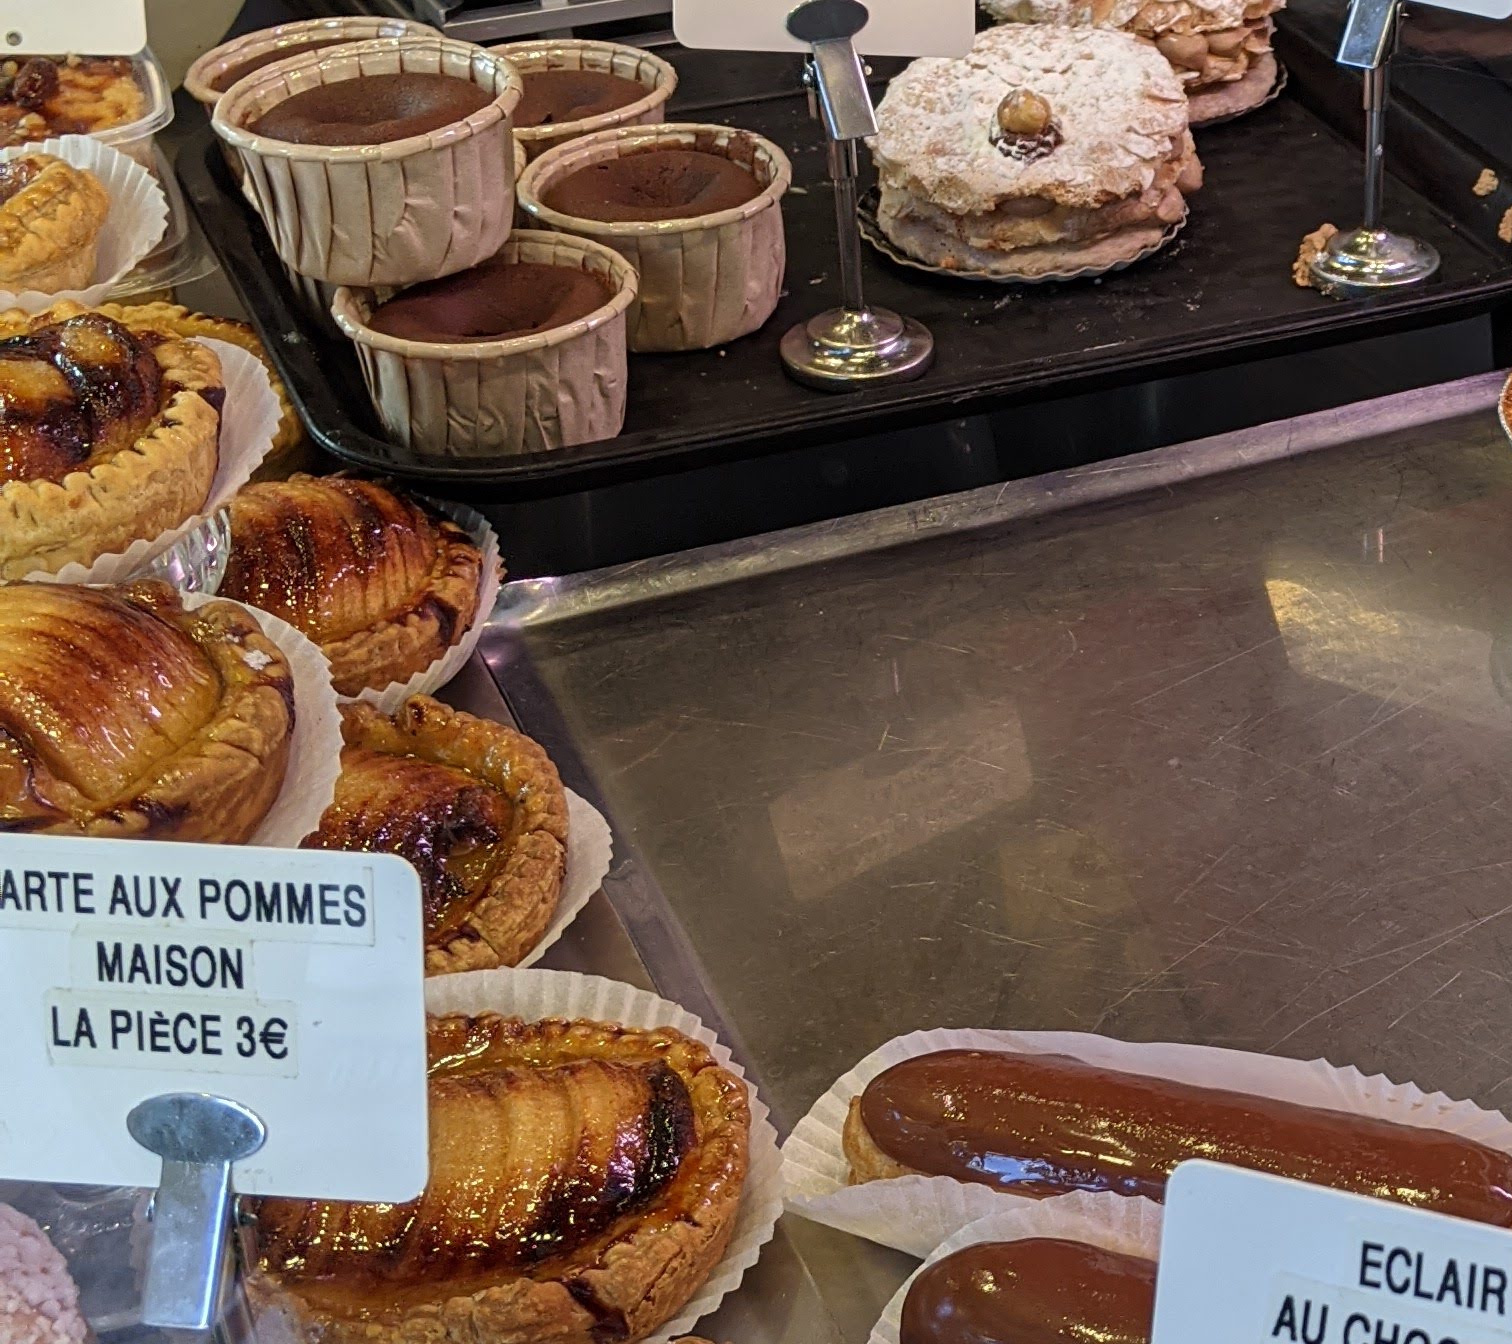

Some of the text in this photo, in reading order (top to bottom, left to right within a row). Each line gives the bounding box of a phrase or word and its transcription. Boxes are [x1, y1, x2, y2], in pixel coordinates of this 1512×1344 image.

[108, 875, 185, 919] AUX
[200, 878, 367, 927] POMMES
[96, 941, 245, 990] MAISON
[51, 1005, 290, 1060] LA PIÈCE 3€
[1359, 1240, 1508, 1315] ECLAIR
